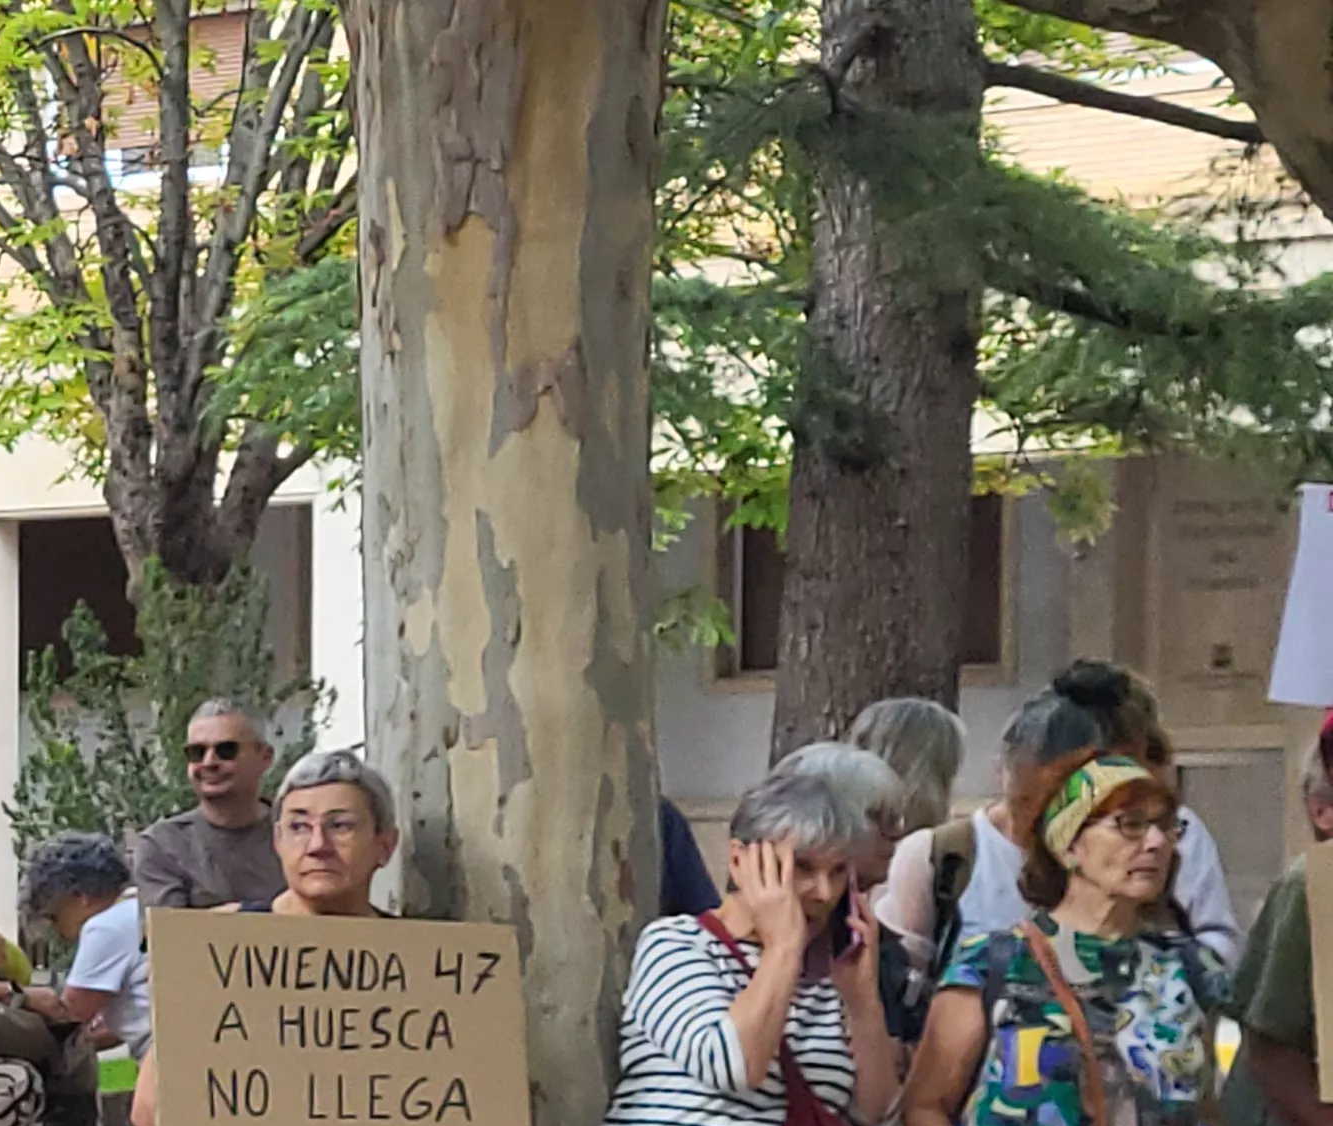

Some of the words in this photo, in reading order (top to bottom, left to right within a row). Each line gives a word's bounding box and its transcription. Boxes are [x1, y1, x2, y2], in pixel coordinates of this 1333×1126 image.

[206, 942, 408, 993] VIVIENDA
[433, 947, 503, 996] 47
[213, 1001, 250, 1045] A
[278, 1004, 454, 1052] HUESCA
[207, 1067, 270, 1120] NO
[308, 1072, 474, 1124] LLEGA
